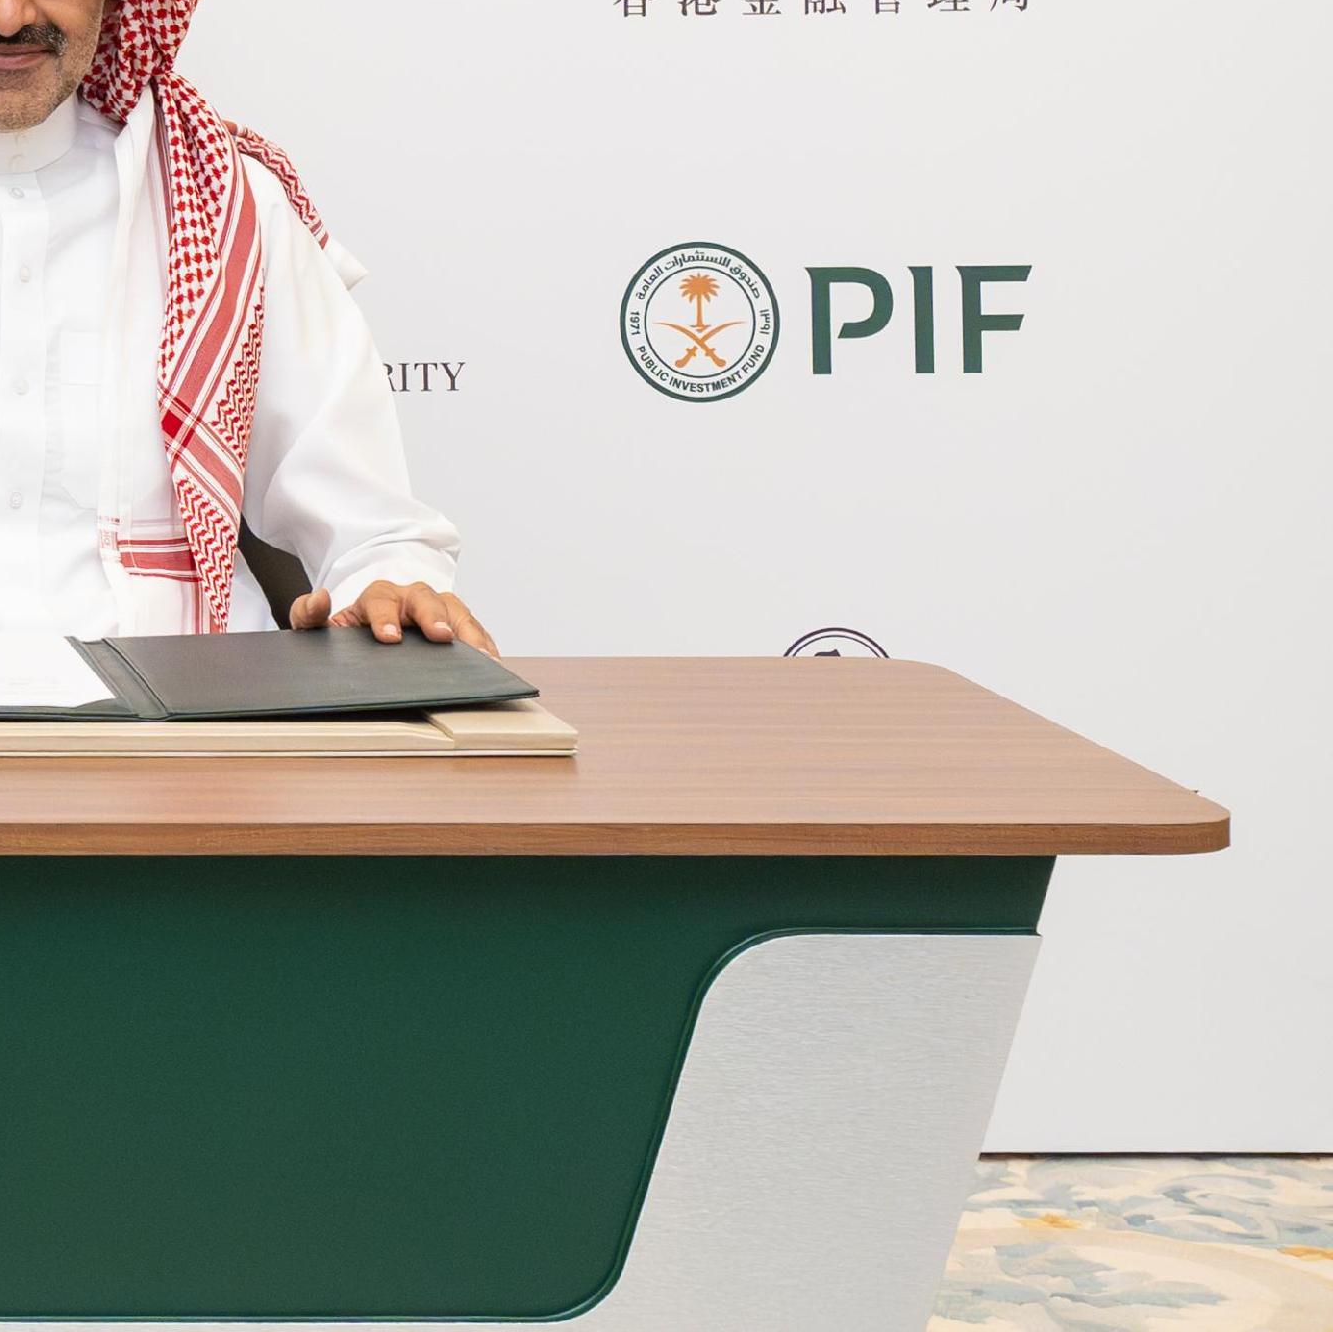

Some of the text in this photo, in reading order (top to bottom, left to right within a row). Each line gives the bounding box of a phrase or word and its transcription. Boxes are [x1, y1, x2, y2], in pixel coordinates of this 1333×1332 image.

[636, 250, 760, 300] صندوق الاستثمارات العامة
[630, 311, 640, 335] 1971
[805, 265, 1032, 374] PIF
[637, 345, 764, 392] PUBLIC INVESTMENT FUND
